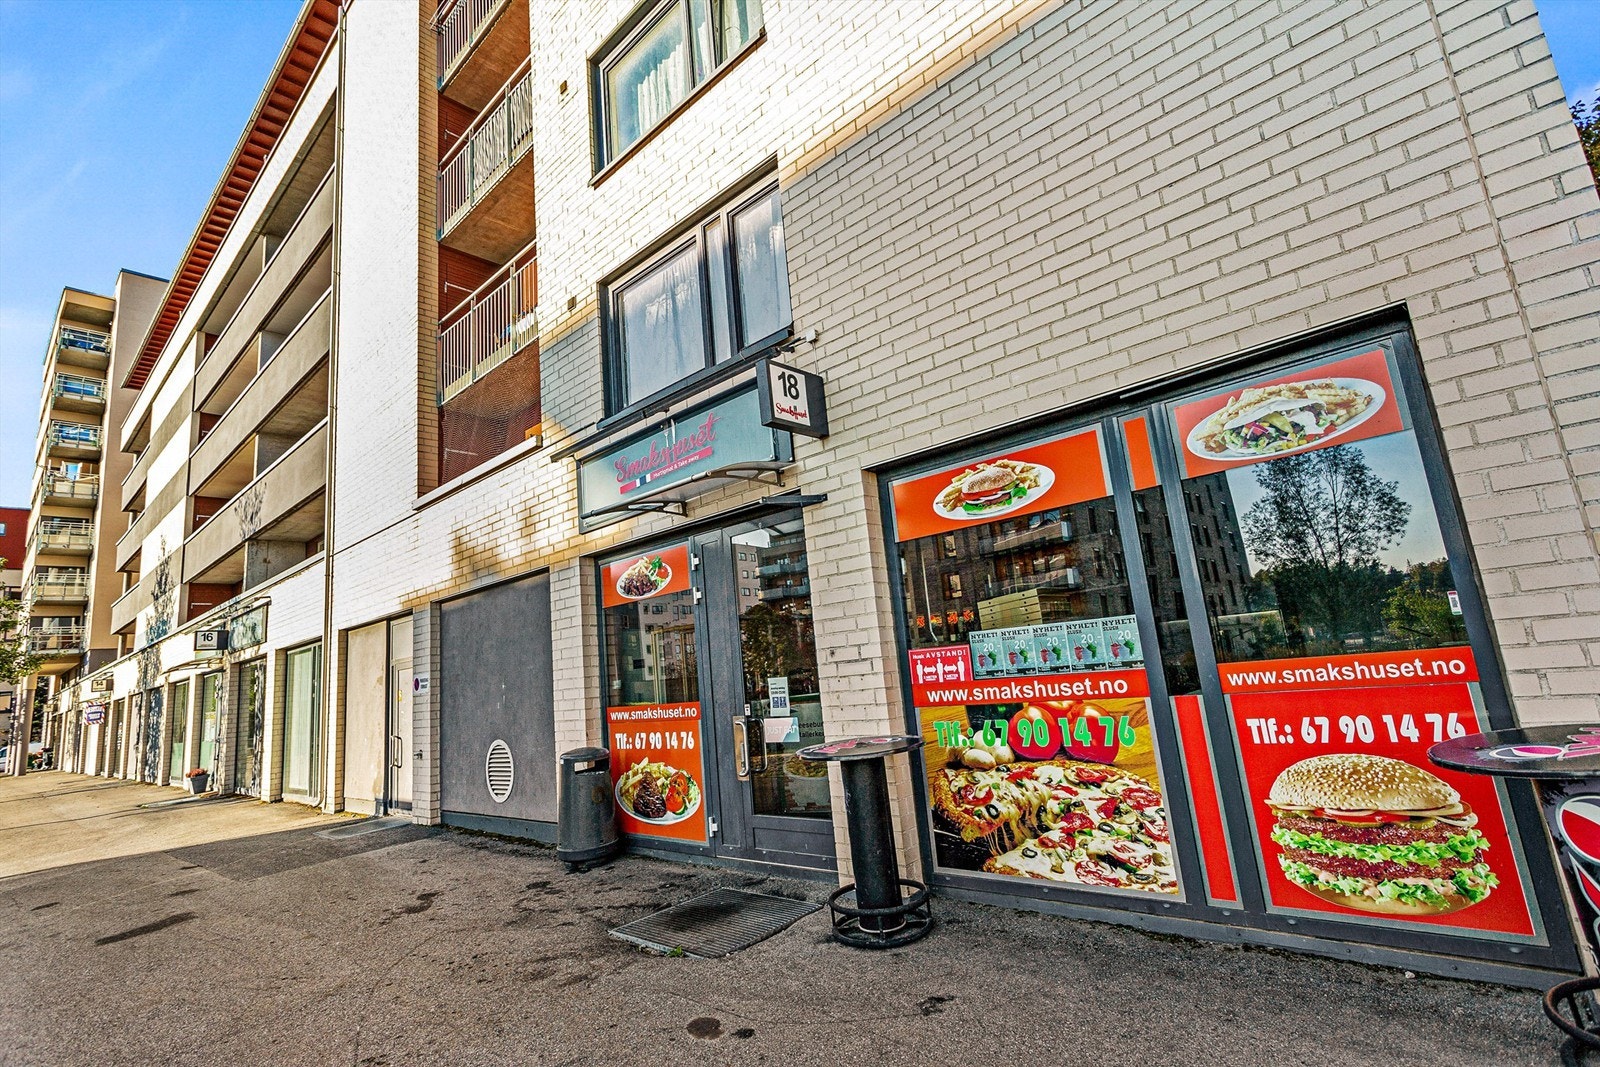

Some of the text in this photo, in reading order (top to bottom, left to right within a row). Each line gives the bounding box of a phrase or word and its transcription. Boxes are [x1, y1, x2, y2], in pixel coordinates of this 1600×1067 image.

[778, 371, 800, 400] 18
[1032, 625, 1063, 634] NYHET!
[1065, 622, 1098, 630] NYHET!
[1101, 617, 1136, 627] NYHET!
[201, 632, 214, 642] 16
[925, 649, 966, 659] AVSTAND!
[1227, 658, 1467, 686] www.smakshuset.no
[926, 678, 1128, 703] www.smakshuset.no
[610, 706, 698, 721] www.smakshuset.no
[933, 715, 1137, 748] Tlf.: 67 90 14 76
[1246, 712, 1467, 745] Tlf.: 67 90 14 76
[615, 731, 695, 750] Tlf.: 67 90 14 76
